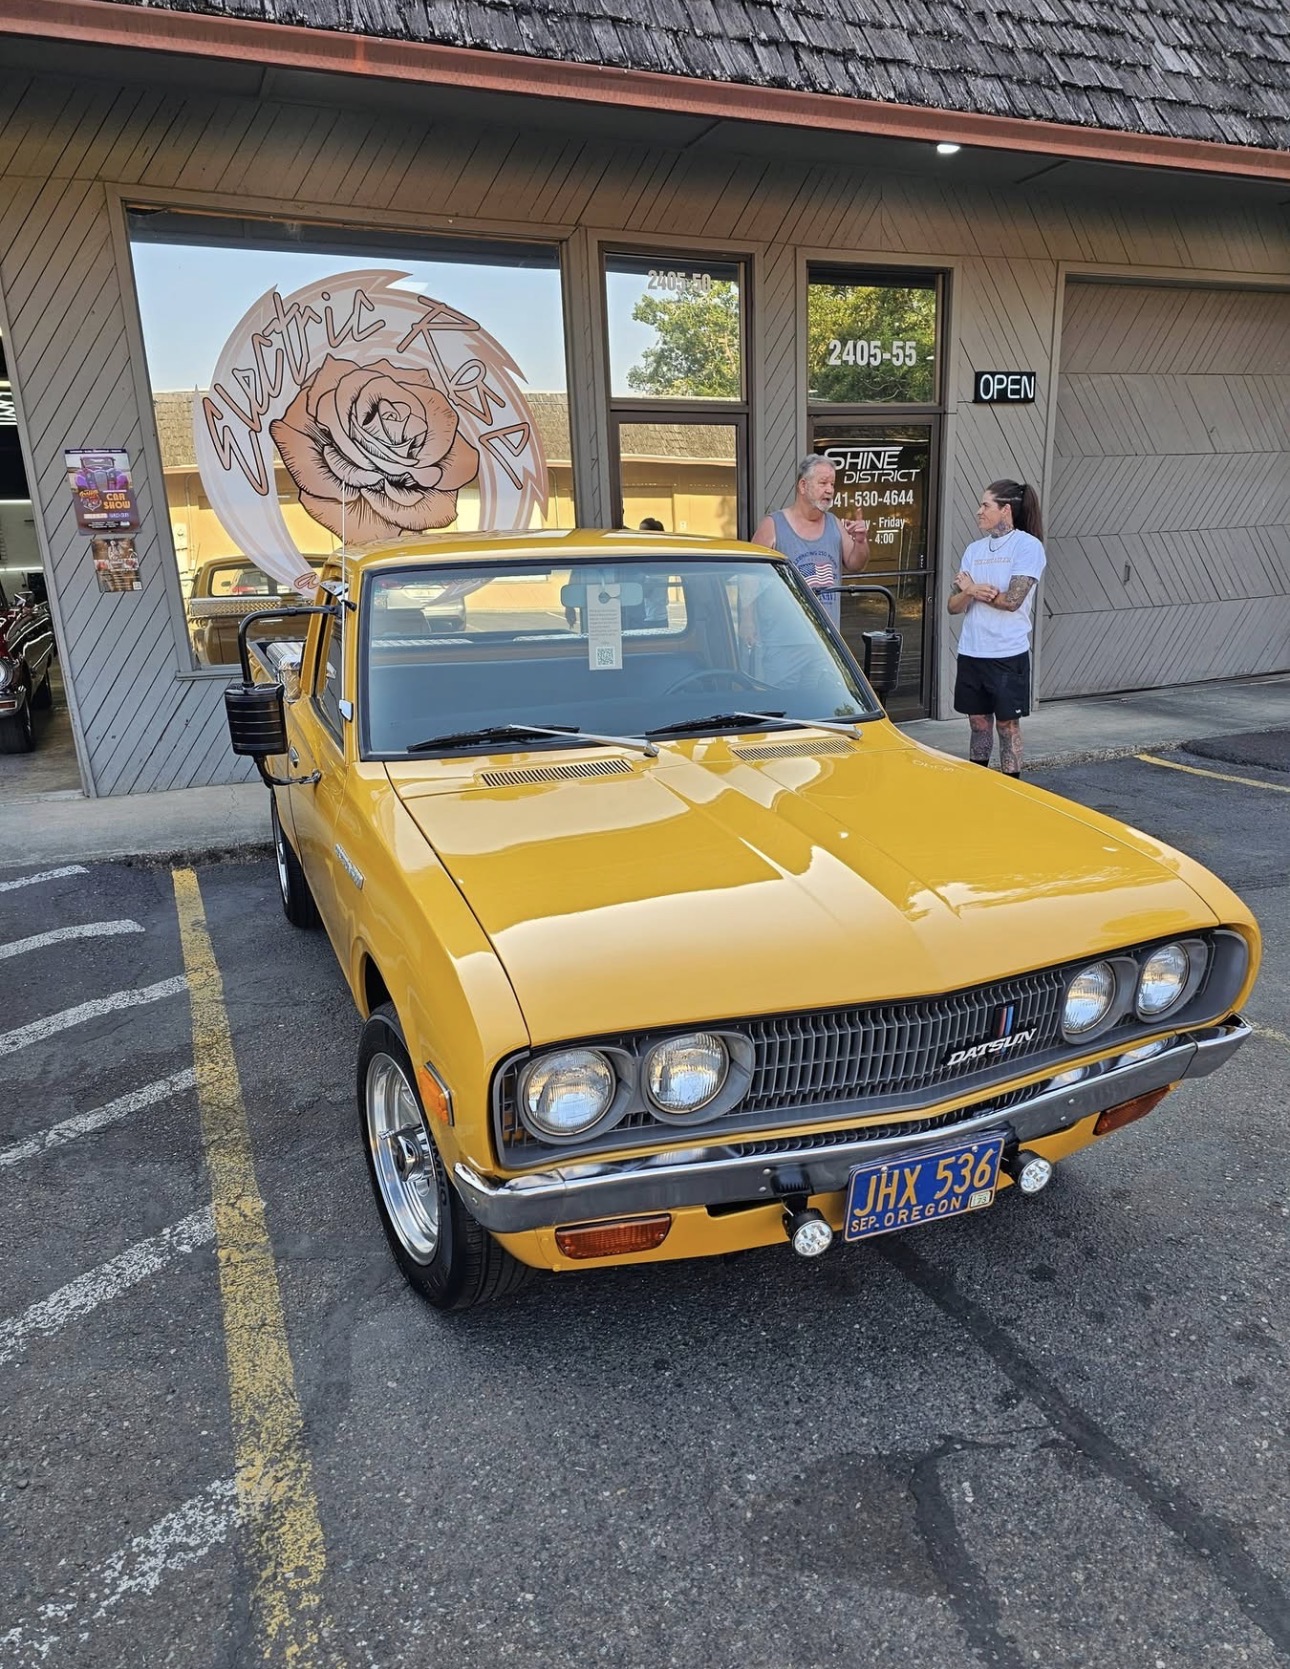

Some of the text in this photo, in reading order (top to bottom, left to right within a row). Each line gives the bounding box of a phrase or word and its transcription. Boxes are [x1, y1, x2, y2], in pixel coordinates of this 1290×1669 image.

[648, 269, 711, 293] 2405-50
[828, 339, 917, 366] 2405-55
[980, 374, 1035, 400] OPEN
[824, 446, 904, 471] SHINE
[844, 469, 921, 484] DISTRICT
[103, 501, 131, 510] SHOW
[106, 493, 125, 501] CAR
[831, 489, 914, 508] 41-530-4644
[879, 517, 905, 530] Friday
[874, 533, 894, 545] 4:00
[947, 1027, 1037, 1066] DATSUN
[853, 1147, 995, 1217] JHX 536
[850, 1195, 962, 1233] SEP. OREGON
